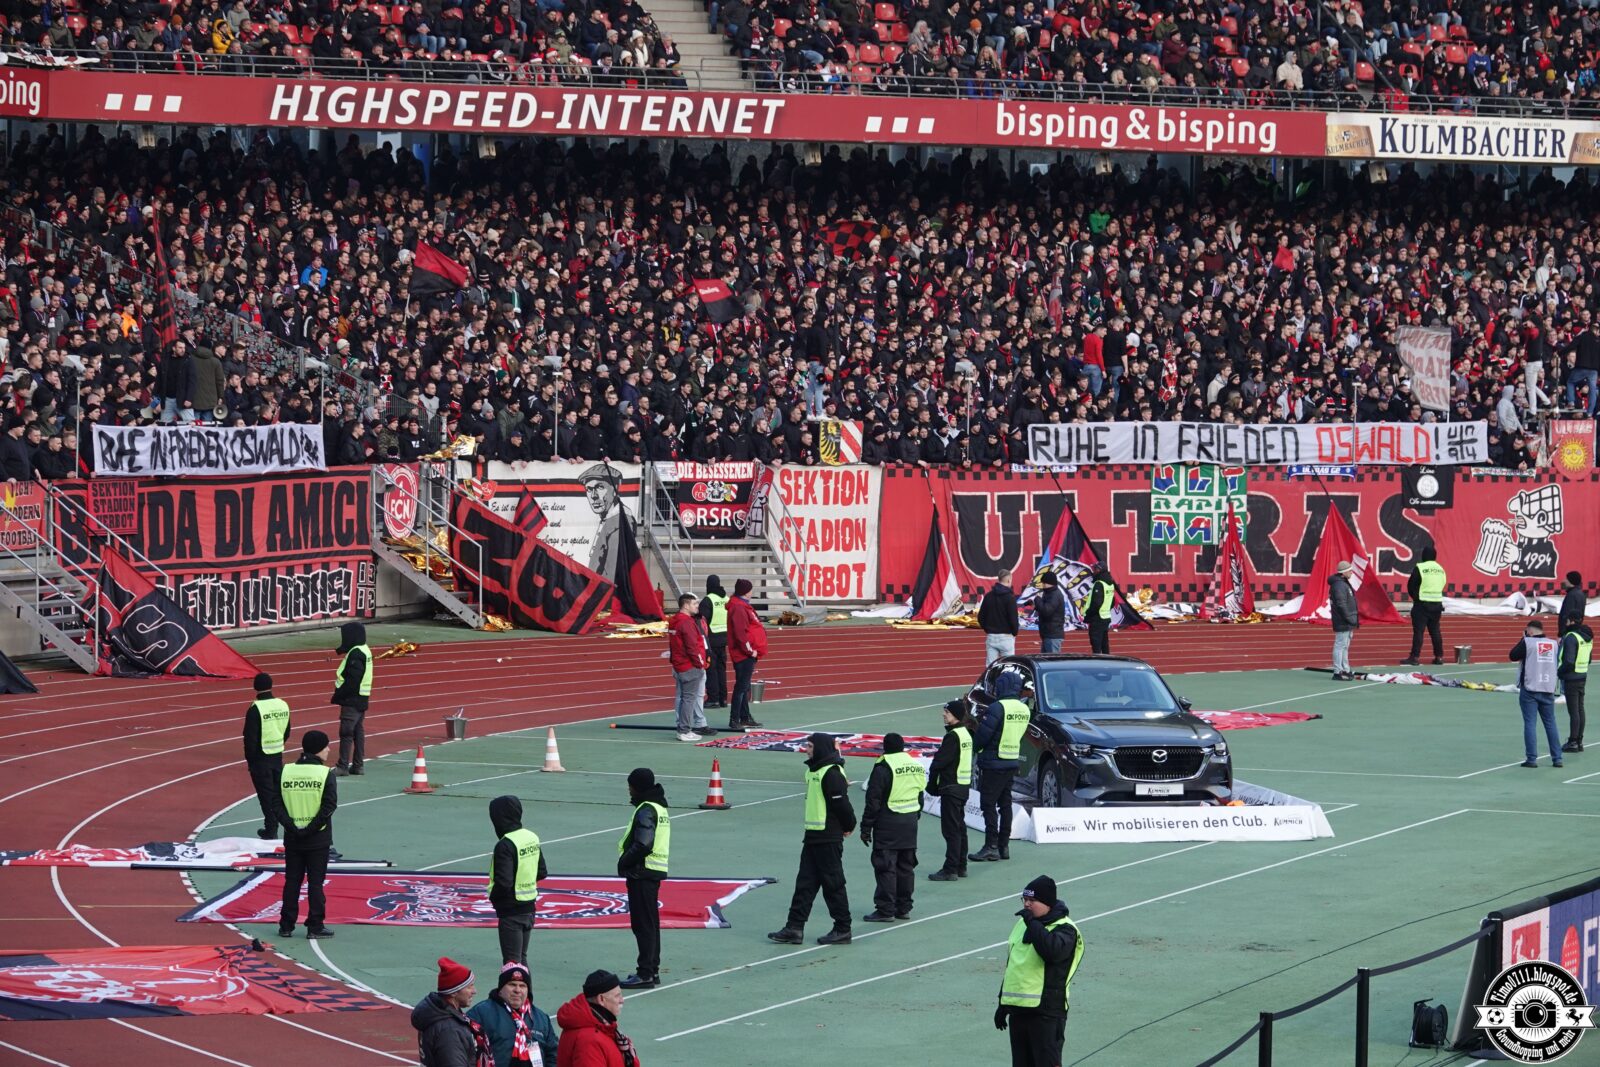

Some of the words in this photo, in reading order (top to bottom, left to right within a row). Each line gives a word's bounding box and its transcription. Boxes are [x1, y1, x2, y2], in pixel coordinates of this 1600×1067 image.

[269, 83, 786, 136] HIGHSPEED-INTERNET
[996, 102, 1119, 149] bisping
[1125, 108, 1151, 141] &
[1156, 107, 1278, 153] bisping
[1379, 117, 1566, 158] KULMBACHER
[1031, 423, 1111, 463] RUHE
[677, 461, 694, 479] DIE
[695, 460, 755, 480] BESESSENEN
[91, 481, 135, 498] SEKTION
[779, 468, 869, 507] SEKTION
[93, 497, 135, 514] STADION
[390, 498, 411, 520] FCN
[1153, 496, 1245, 511] RAPID
[214, 487, 256, 559] DI
[266, 480, 370, 553] AMICI
[696, 507, 732, 526] RSR
[779, 517, 868, 553] STADION
[951, 488, 1437, 581] ULTRAS
[1523, 551, 1553, 570] 1994
[1538, 673, 1550, 683] 13
[294, 780, 322, 789] POWER
[1083, 818, 1109, 833] Wir
[1112, 816, 1200, 832] mobilisieren
[1203, 816, 1228, 830] den
[1232, 814, 1268, 829] Club.
[1583, 914, 1600, 990] F
